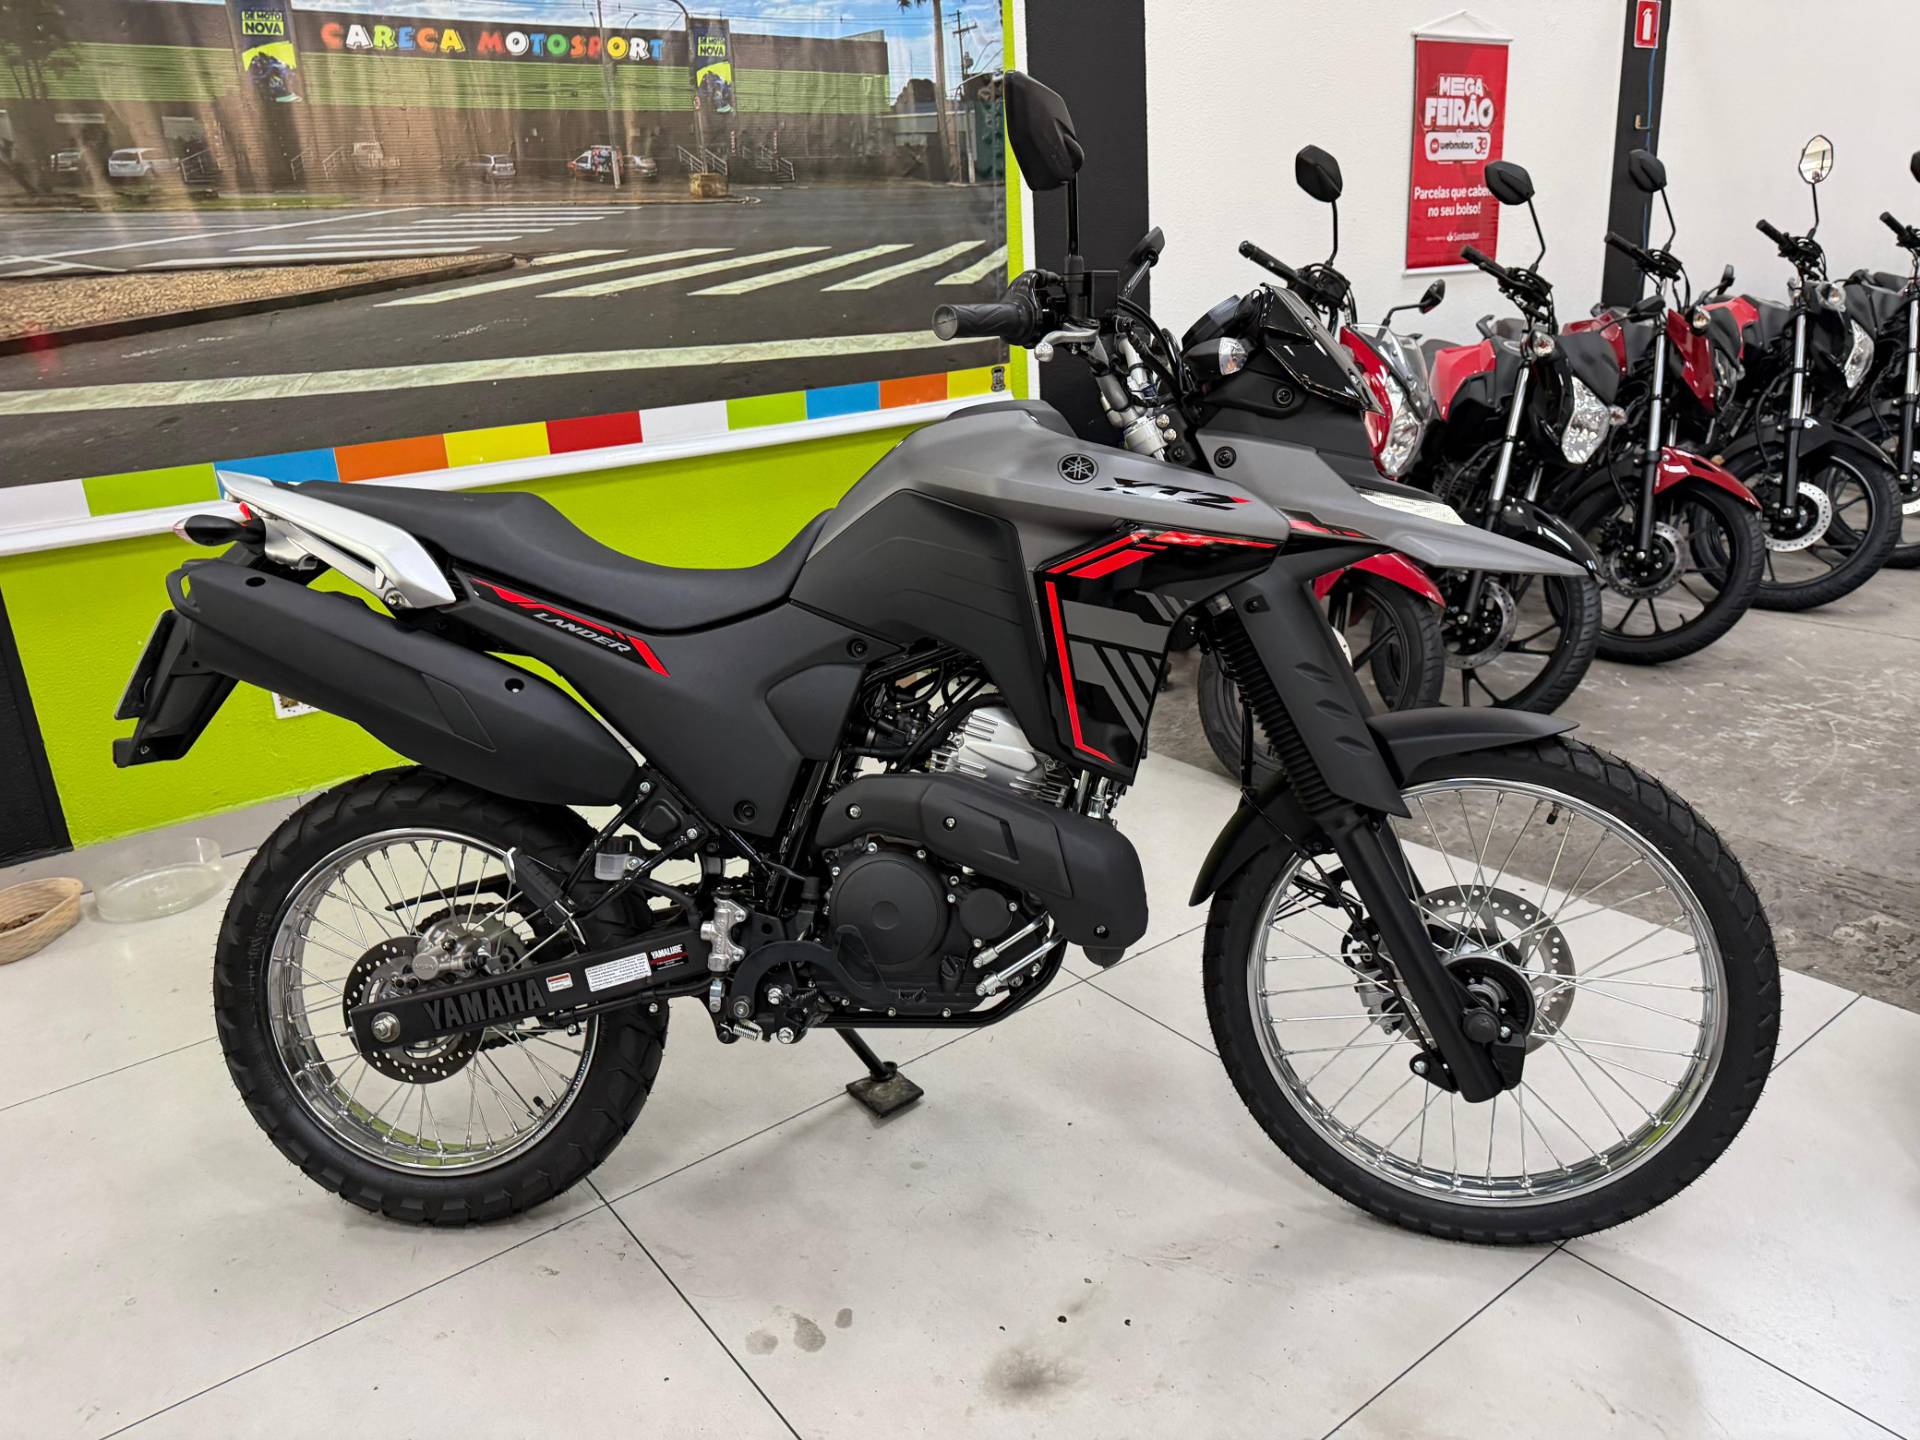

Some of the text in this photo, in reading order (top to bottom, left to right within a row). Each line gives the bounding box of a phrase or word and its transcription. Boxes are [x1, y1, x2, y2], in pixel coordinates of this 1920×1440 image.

[245, 22, 282, 34] NOVA
[320, 22, 664, 61] CARECA MOTOSPORT
[700, 46, 724, 56] NOVA
[1439, 76, 1483, 97] MEGA
[1424, 94, 1494, 128] FEIRÃO
[1414, 186, 1450, 200] Parcelas
[1451, 188, 1467, 201] que
[1428, 202, 1481, 217] no seu bolso!
[533, 613, 632, 652] LANDER
[423, 979, 546, 1030] YAMAHA
